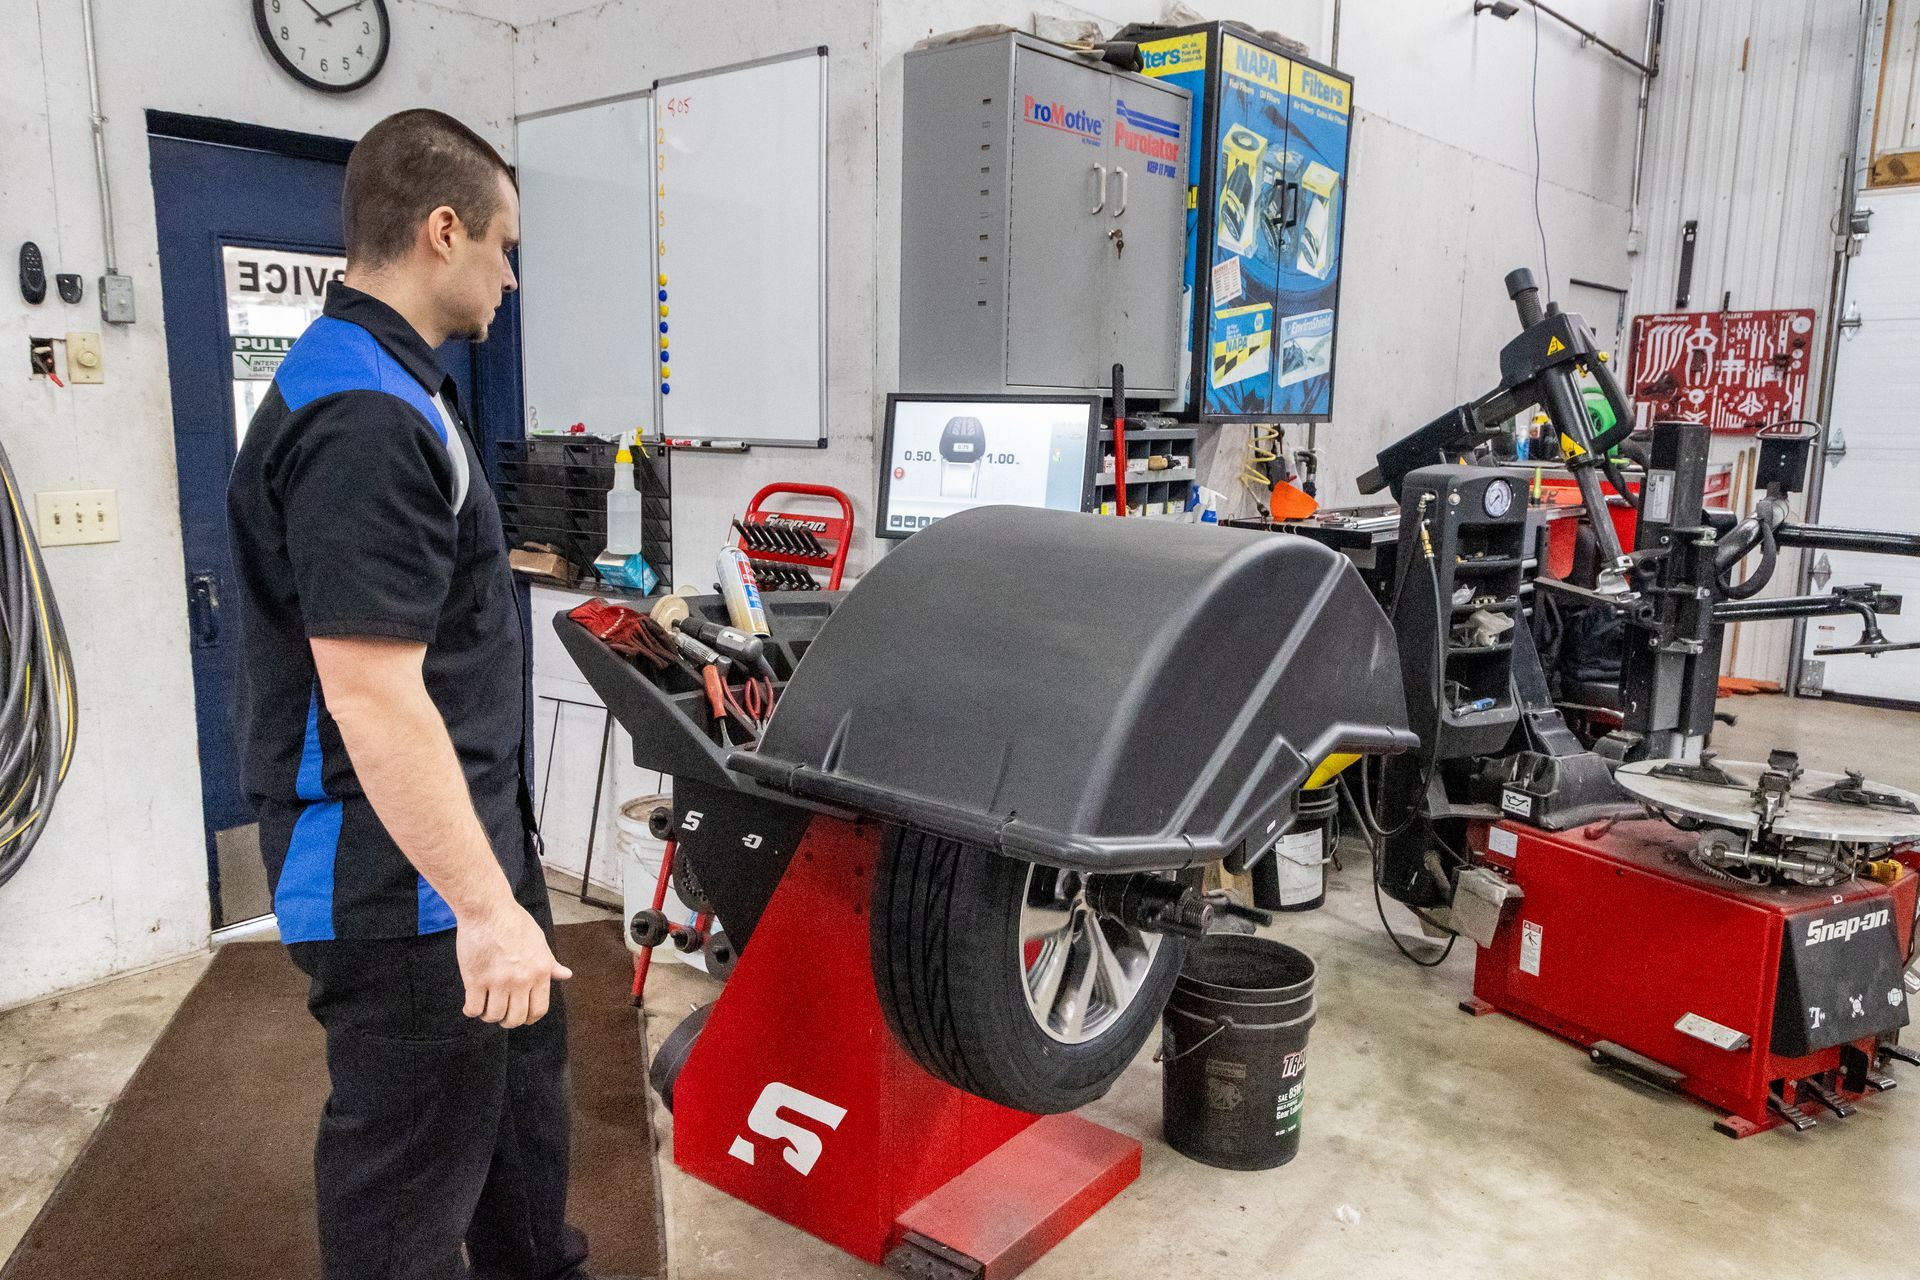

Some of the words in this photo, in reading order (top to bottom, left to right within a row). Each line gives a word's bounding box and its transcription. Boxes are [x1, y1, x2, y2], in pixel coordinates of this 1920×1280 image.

[272, 0, 280, 13] 9
[281, 26, 289, 40] 8
[362, 21, 370, 35] 3
[298, 47, 306, 60] 7
[356, 45, 363, 57] 4
[320, 58, 328, 72] 6
[342, 57, 350, 70] 5
[1236, 45, 1278, 85] NAPA
[1301, 70, 1343, 107] Filters
[1024, 95, 1101, 136] ProMotive
[658, 127, 664, 144] 2
[1115, 121, 1180, 162] Purolator
[658, 154, 665, 172] 3
[658, 183, 665, 200] 4
[659, 211, 665, 228] 5
[659, 239, 665, 257] 6
[1652, 315, 1689, 323] Snap-on
[1719, 312, 1742, 321] PLLER
[235, 337, 291, 351] PULL
[1226, 336, 1248, 354] NAPA
[904, 451, 932, 462] 0.50
[986, 453, 1015, 465] 1.00
[1805, 909, 1889, 947] Snap-on
[1277, 1094, 1289, 1103] SAE
[1276, 1109, 1290, 1120] Gear
